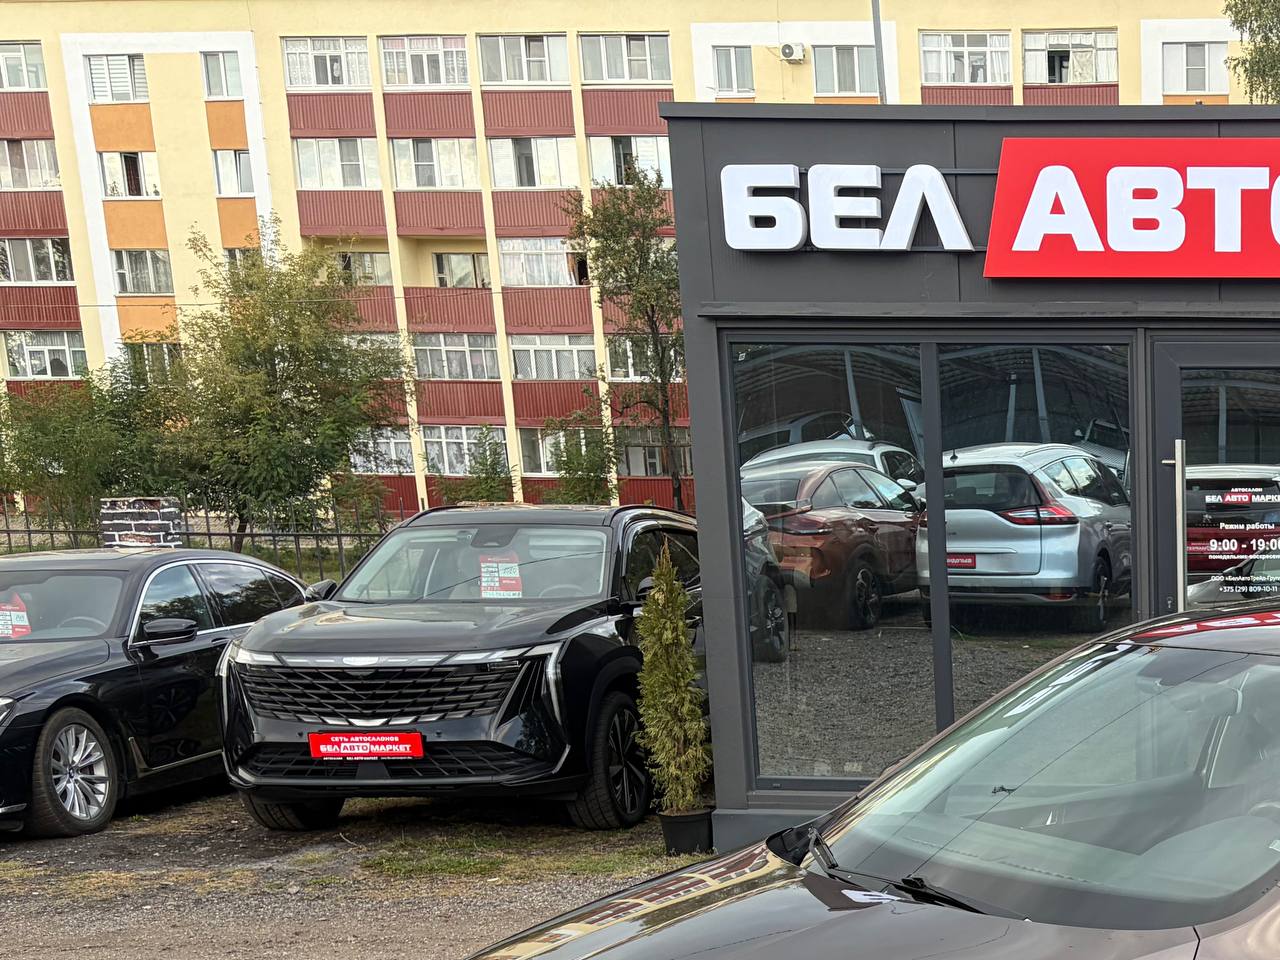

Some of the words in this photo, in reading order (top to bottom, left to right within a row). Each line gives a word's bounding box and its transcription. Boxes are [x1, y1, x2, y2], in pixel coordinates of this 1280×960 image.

[720, 163, 976, 253] БЕЛ
[1205, 495, 1222, 503] БЕЛ
[1225, 494, 1249, 502] АВТО
[1219, 522, 1245, 530] Режим
[1246, 522, 1275, 531] работы
[1209, 538, 1238, 551] 9:00
[1235, 585, 1248, 593] (29)
[320, 744, 339, 753] БЕЛ
[342, 744, 369, 752] АВТО
[370, 744, 412, 752] МАРКЕТ
